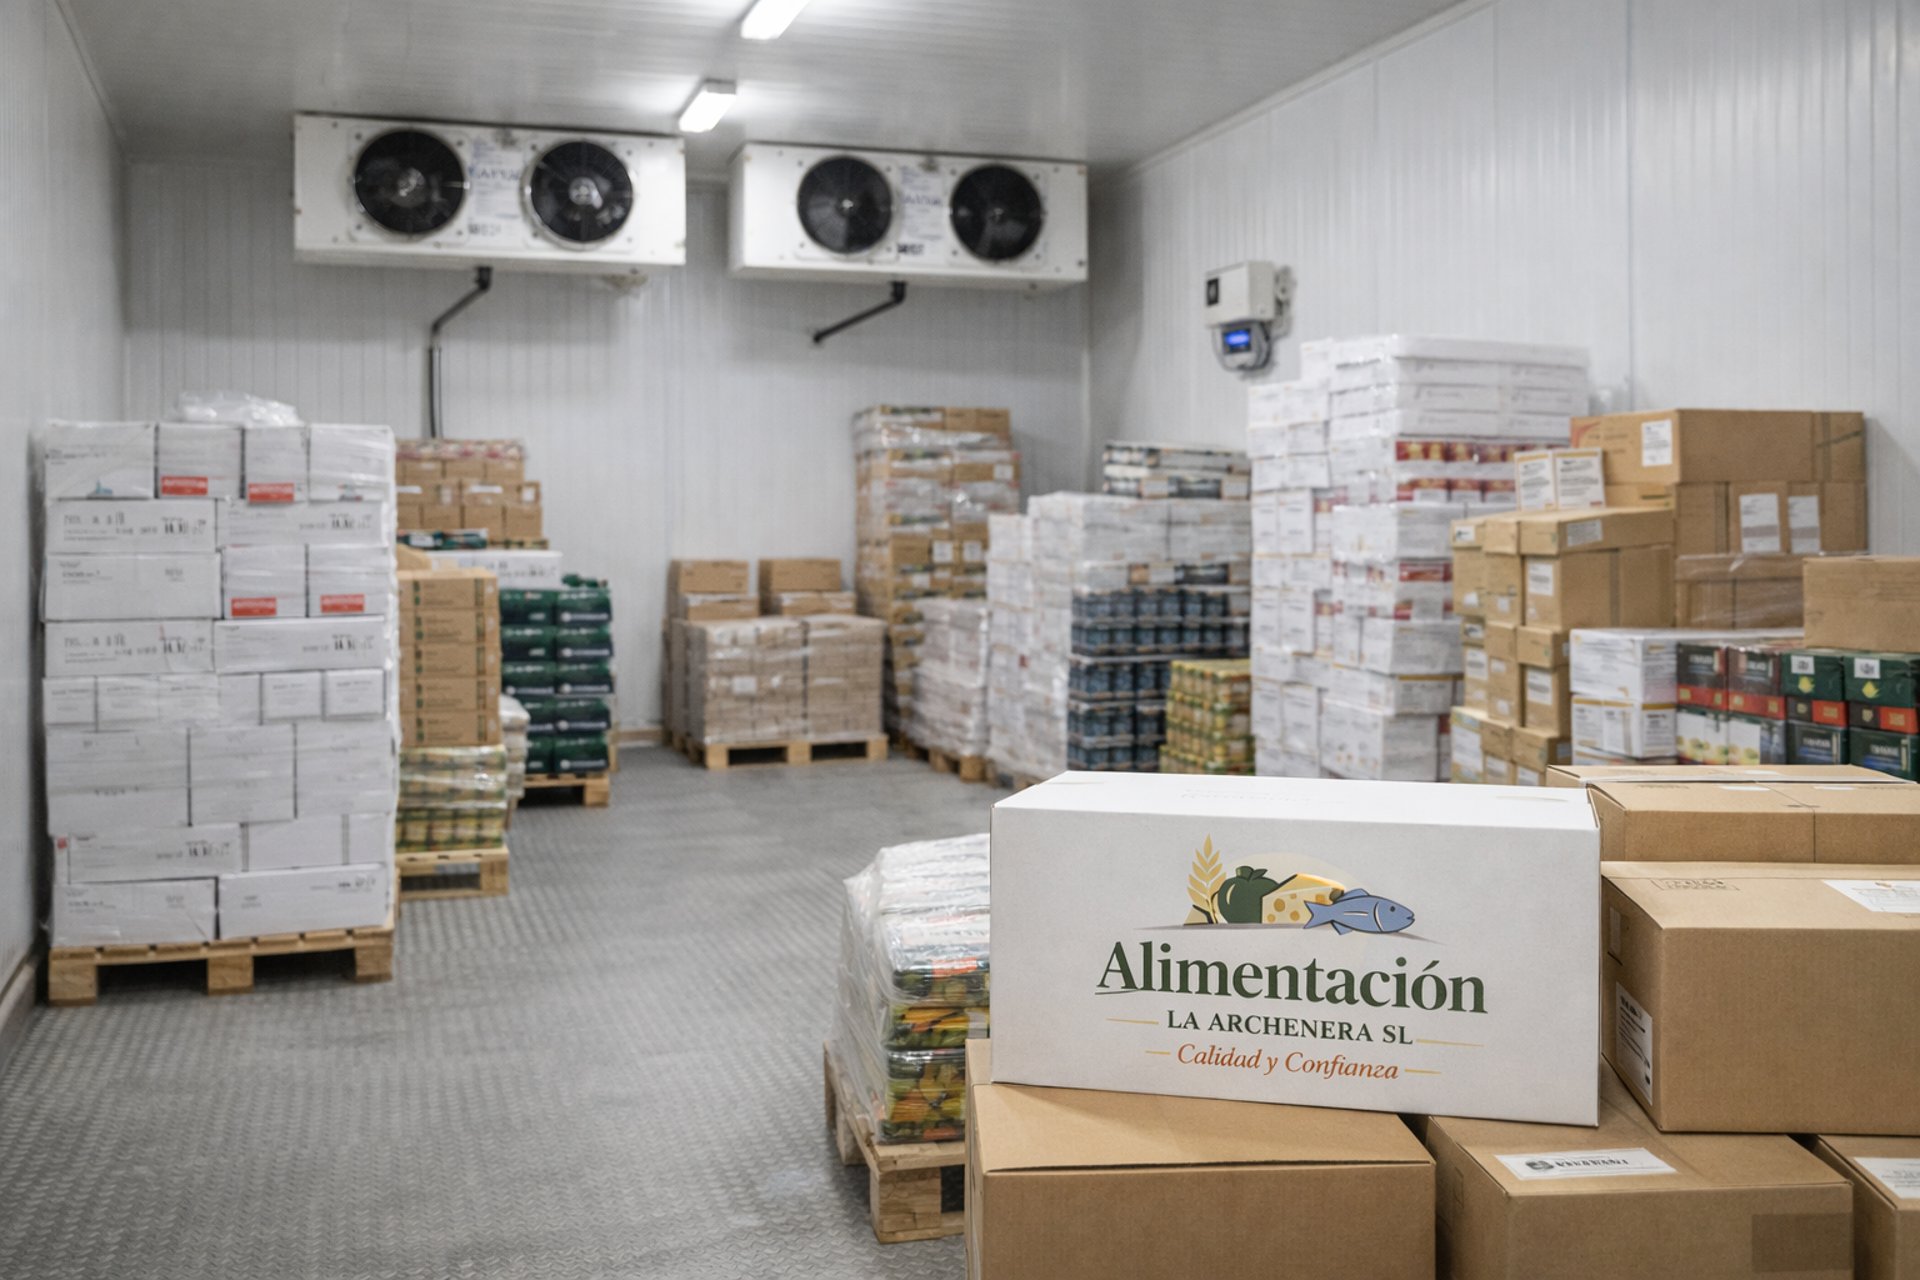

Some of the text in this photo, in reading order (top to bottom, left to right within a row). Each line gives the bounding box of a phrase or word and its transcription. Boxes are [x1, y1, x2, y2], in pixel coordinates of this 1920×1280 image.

[1096, 940, 1488, 1014] Alimentación
[1167, 1010, 1413, 1045] LA ARCHENERA SL
[1177, 1043, 1399, 1080] Calidad y Confianza
